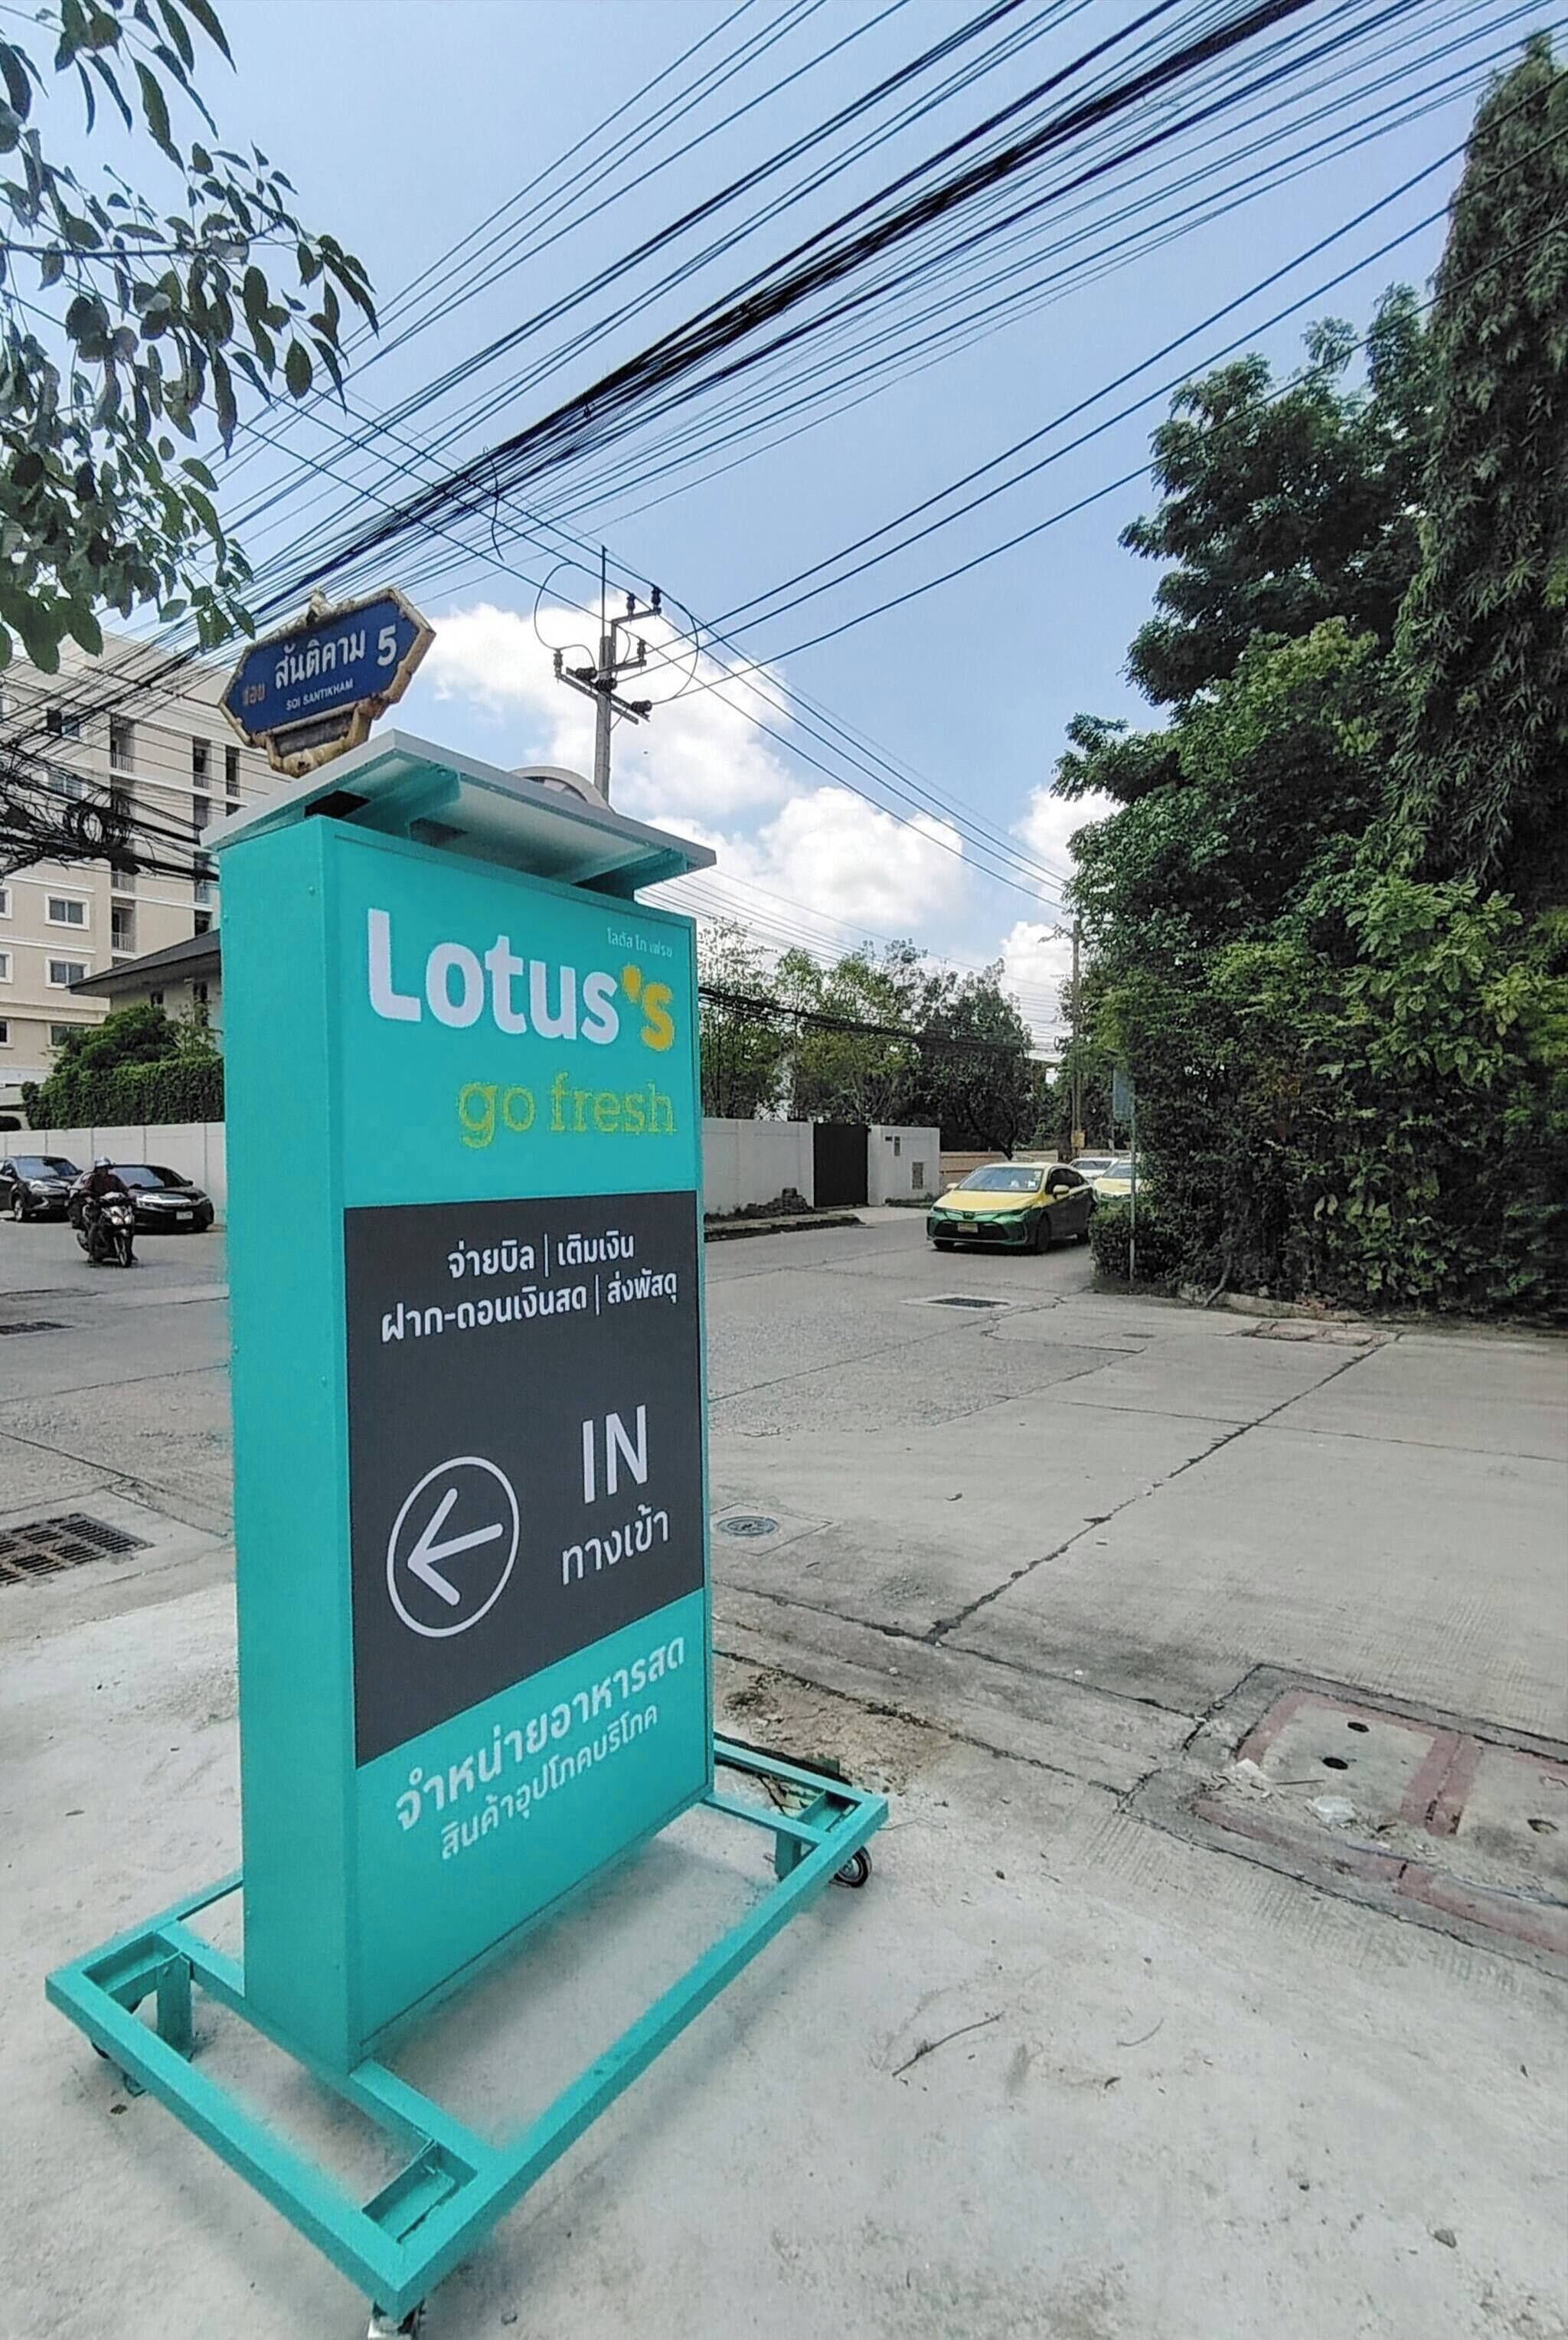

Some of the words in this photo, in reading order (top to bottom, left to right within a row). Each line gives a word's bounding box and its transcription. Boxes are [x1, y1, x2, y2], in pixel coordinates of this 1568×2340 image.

[275, 629, 365, 689] สันติคาม
[377, 624, 397, 667] 5
[286, 697, 301, 711] SOI
[302, 678, 353, 705] SANTIKHAM
[368, 907, 675, 1051] Lotus's
[458, 1081, 536, 1149] go
[550, 1072, 676, 1136] fresh
[447, 1239, 535, 1279] จ่ายบิล
[557, 1230, 635, 1266] เติมเงิน
[606, 1267, 678, 1305] ส่งพัสดุ
[582, 1404, 648, 1504] IN
[561, 1503, 670, 1586] ทางเข้า
[395, 1636, 686, 1832] จำหน่ายอาหารสด
[440, 1704, 658, 1861] สินค้าอุปโภคบริโภค
